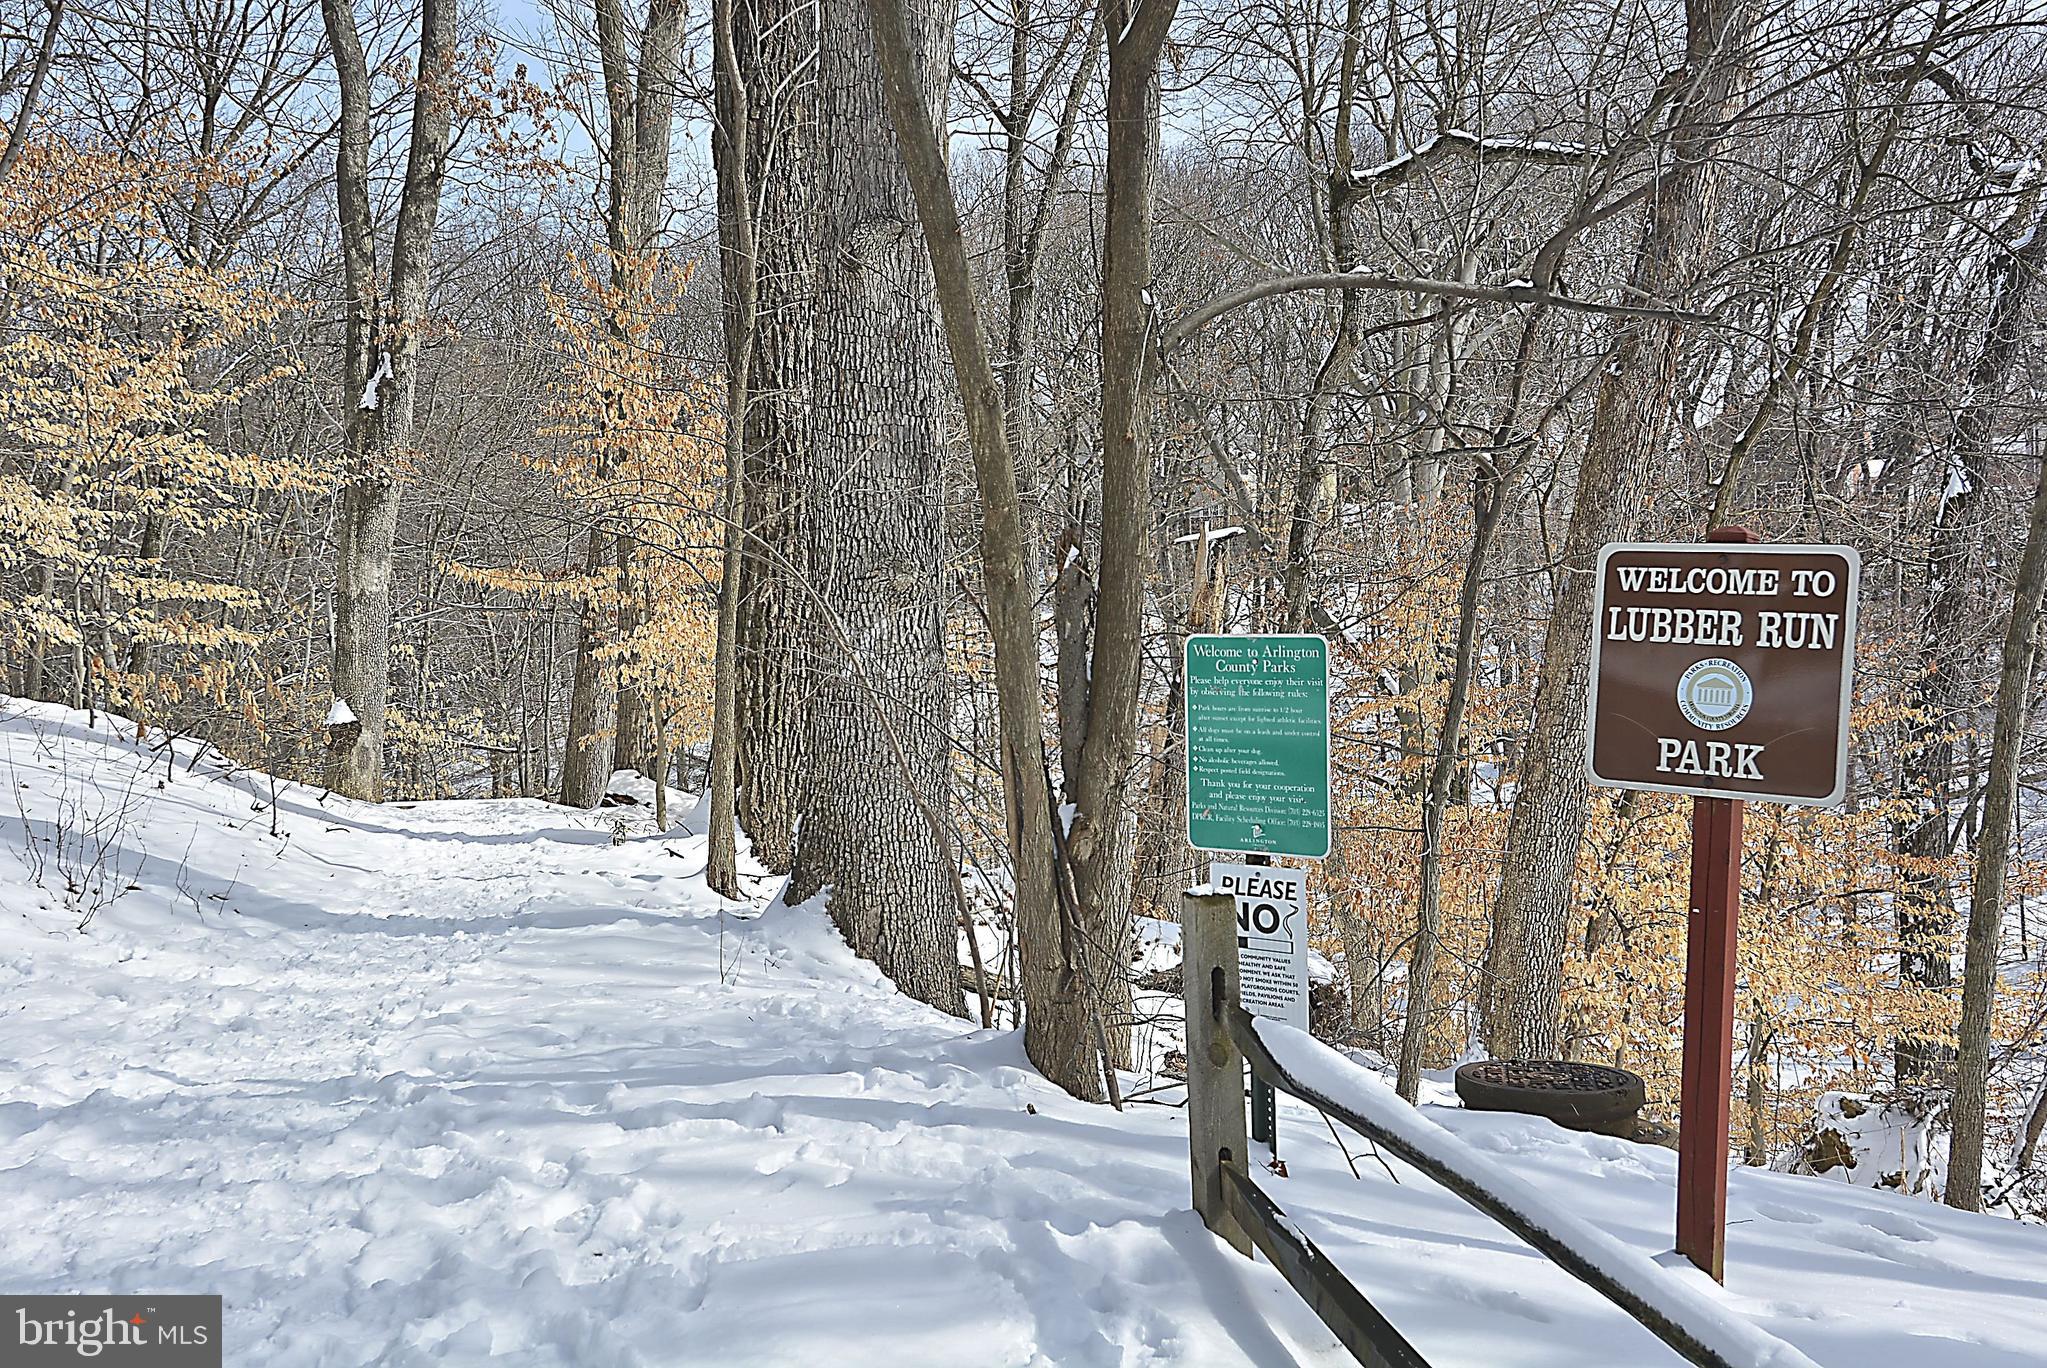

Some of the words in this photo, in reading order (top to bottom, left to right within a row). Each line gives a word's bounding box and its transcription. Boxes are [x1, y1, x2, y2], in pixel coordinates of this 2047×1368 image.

[1617, 567, 1779, 595] WELCOME
[1792, 570, 1836, 597] TO
[1607, 607, 1743, 646] LUBBER
[1756, 612, 1839, 649] RUN
[1193, 644, 1242, 658] Welcome
[1248, 648, 1258, 658] to
[1262, 645, 1319, 660] Arlington
[1216, 660, 1258, 676] County
[1263, 660, 1296, 673] Parks
[1684, 663, 1705, 679] PARKS
[1708, 660, 1747, 682] RECREATION
[1190, 676, 1211, 684] Please
[1214, 676, 1230, 686] help
[1231, 678, 1262, 687] everyone
[1264, 678, 1284, 688] enjoy
[1286, 678, 1304, 686] their
[1307, 678, 1323, 686] visit
[1190, 687, 1198, 697] by
[1201, 687, 1236, 697] observing
[1239, 687, 1250, 696] the
[1252, 688, 1284, 698] following
[1680, 700, 1713, 729] COMMUNITY
[1716, 704, 1749, 729] RESOURCES
[1656, 738, 1765, 780] PARK
[1200, 778, 1226, 788] Thank
[1228, 781, 1240, 790] you
[1243, 780, 1252, 789] for
[1255, 782, 1271, 792] your
[1274, 784, 1315, 793] cooperation
[1209, 791, 1222, 799] and
[1226, 792, 1246, 801] please
[1248, 794, 1266, 802] enjoy
[1270, 795, 1286, 804] your
[1222, 876, 1297, 900] PLEASE
[1237, 902, 1280, 934] NO
[1240, 954, 1271, 962] COMMUNITY
[1242, 984, 1277, 992] PLAYGROUNDS
[1258, 992, 1283, 1000] PAVILIONS
